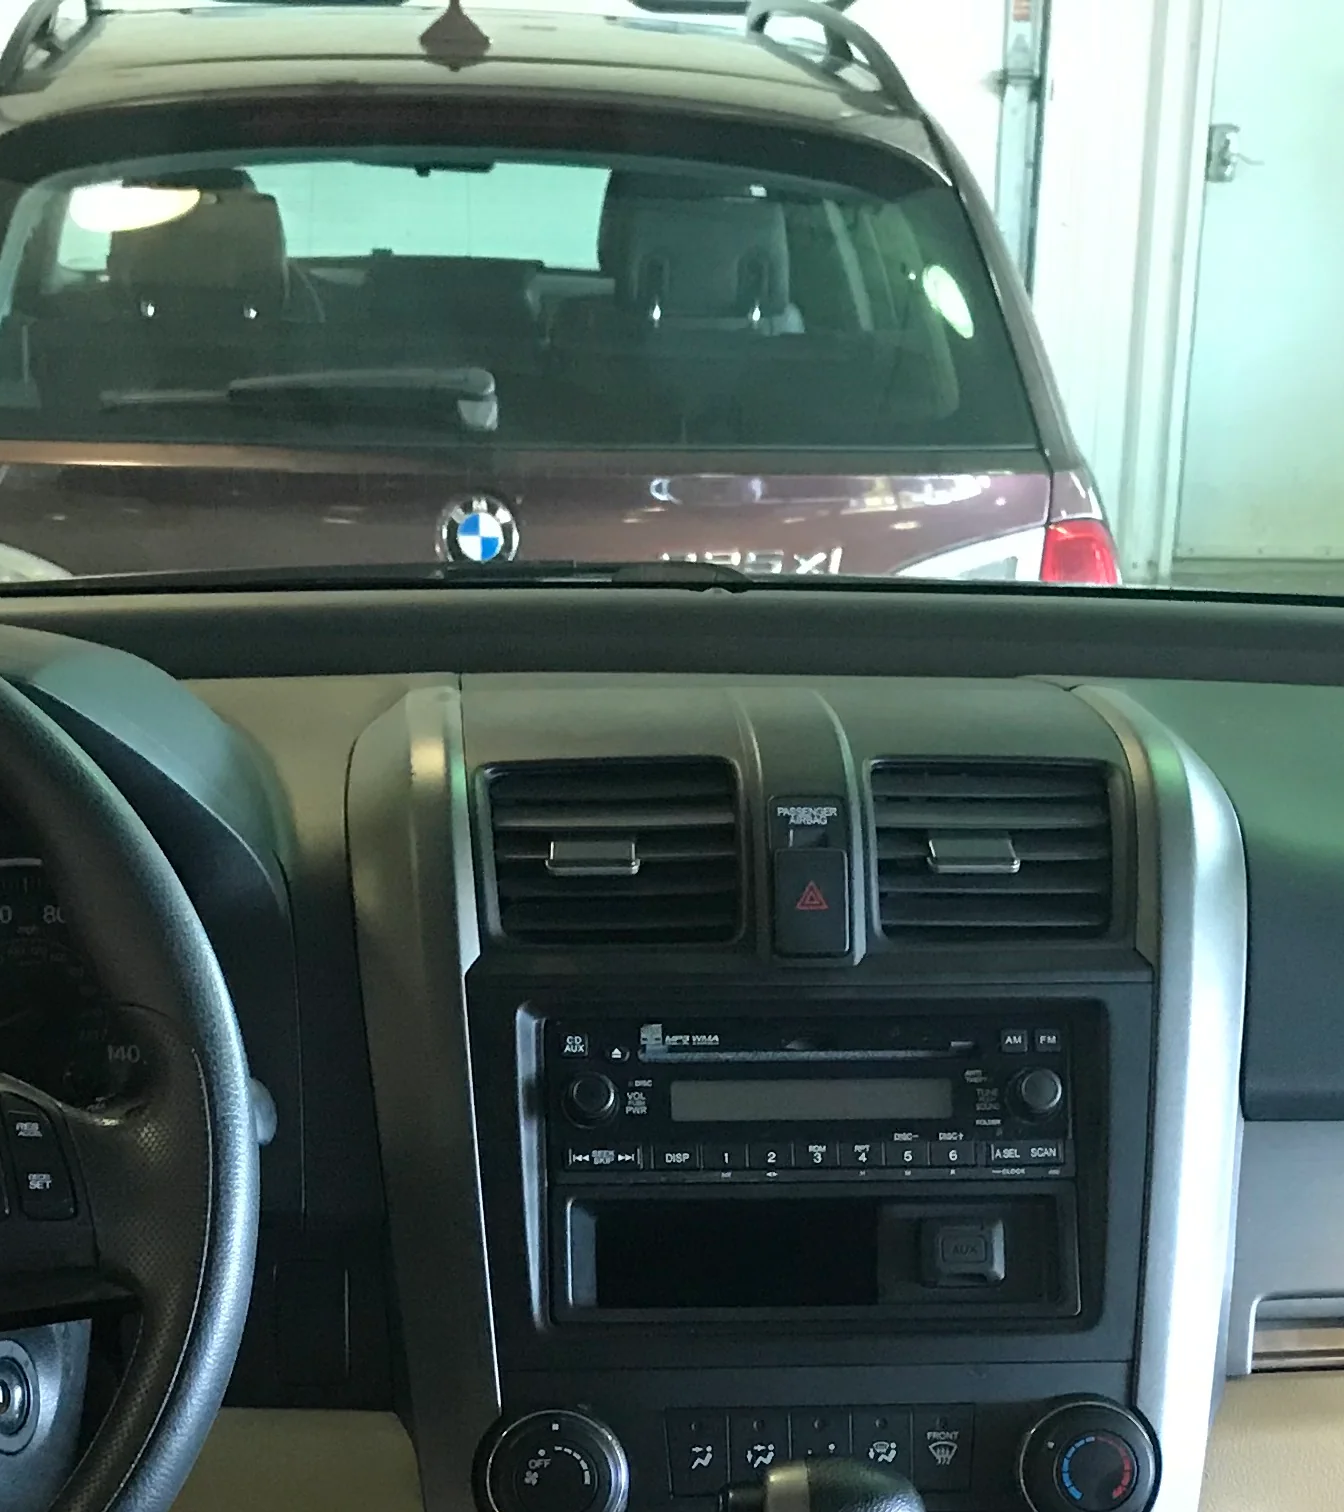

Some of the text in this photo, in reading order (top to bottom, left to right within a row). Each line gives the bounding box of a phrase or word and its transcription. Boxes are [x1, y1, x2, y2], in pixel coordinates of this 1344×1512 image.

[776, 806, 838, 817] PASSENGER
[788, 815, 828, 825] AIRBAG
[566, 1035, 583, 1045] CD
[1004, 1035, 1023, 1045] AM
[1039, 1035, 1057, 1045] FM
[563, 1044, 585, 1054] AUX
[626, 1091, 647, 1101] VOL
[625, 1105, 648, 1115] PWR
[664, 1152, 691, 1164] DISP
[723, 1152, 730, 1164] 1
[766, 1151, 777, 1164] 2
[813, 1151, 823, 1164] 3
[857, 1151, 868, 1163] 4
[903, 1149, 913, 1162] 5
[948, 1149, 958, 1162] 6
[1030, 1147, 1057, 1158] SCAN
[28, 1180, 53, 1190] SET
[926, 1430, 960, 1441] FRONT
[527, 1457, 552, 1470] OFF
